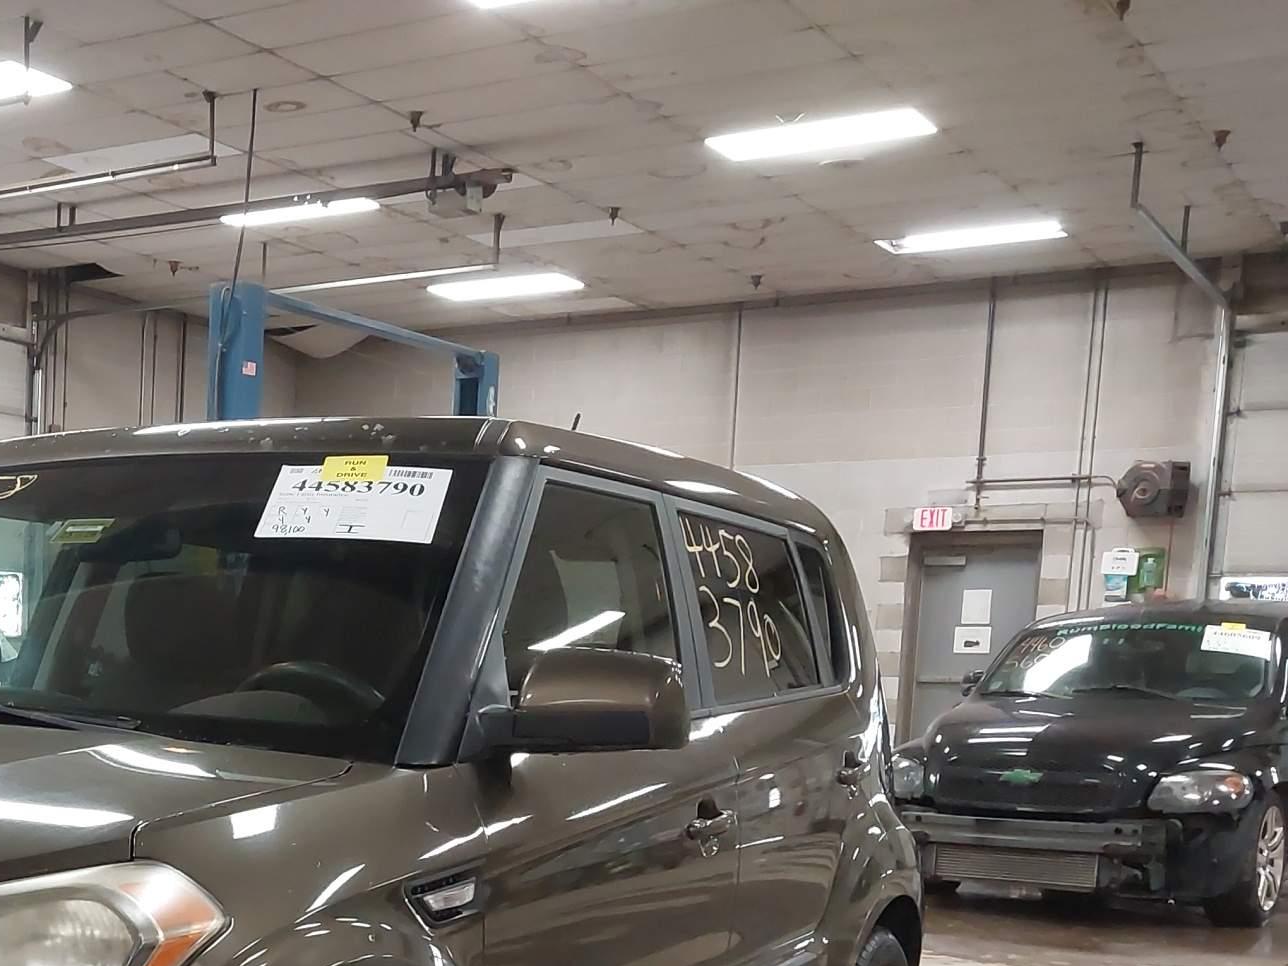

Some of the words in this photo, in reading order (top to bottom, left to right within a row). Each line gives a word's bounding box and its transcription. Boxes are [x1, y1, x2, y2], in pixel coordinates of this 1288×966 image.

[292, 479, 425, 497] 44583790
[920, 508, 948, 529] EXIT
[678, 515, 760, 594] 4458
[698, 585, 782, 678] 3790
